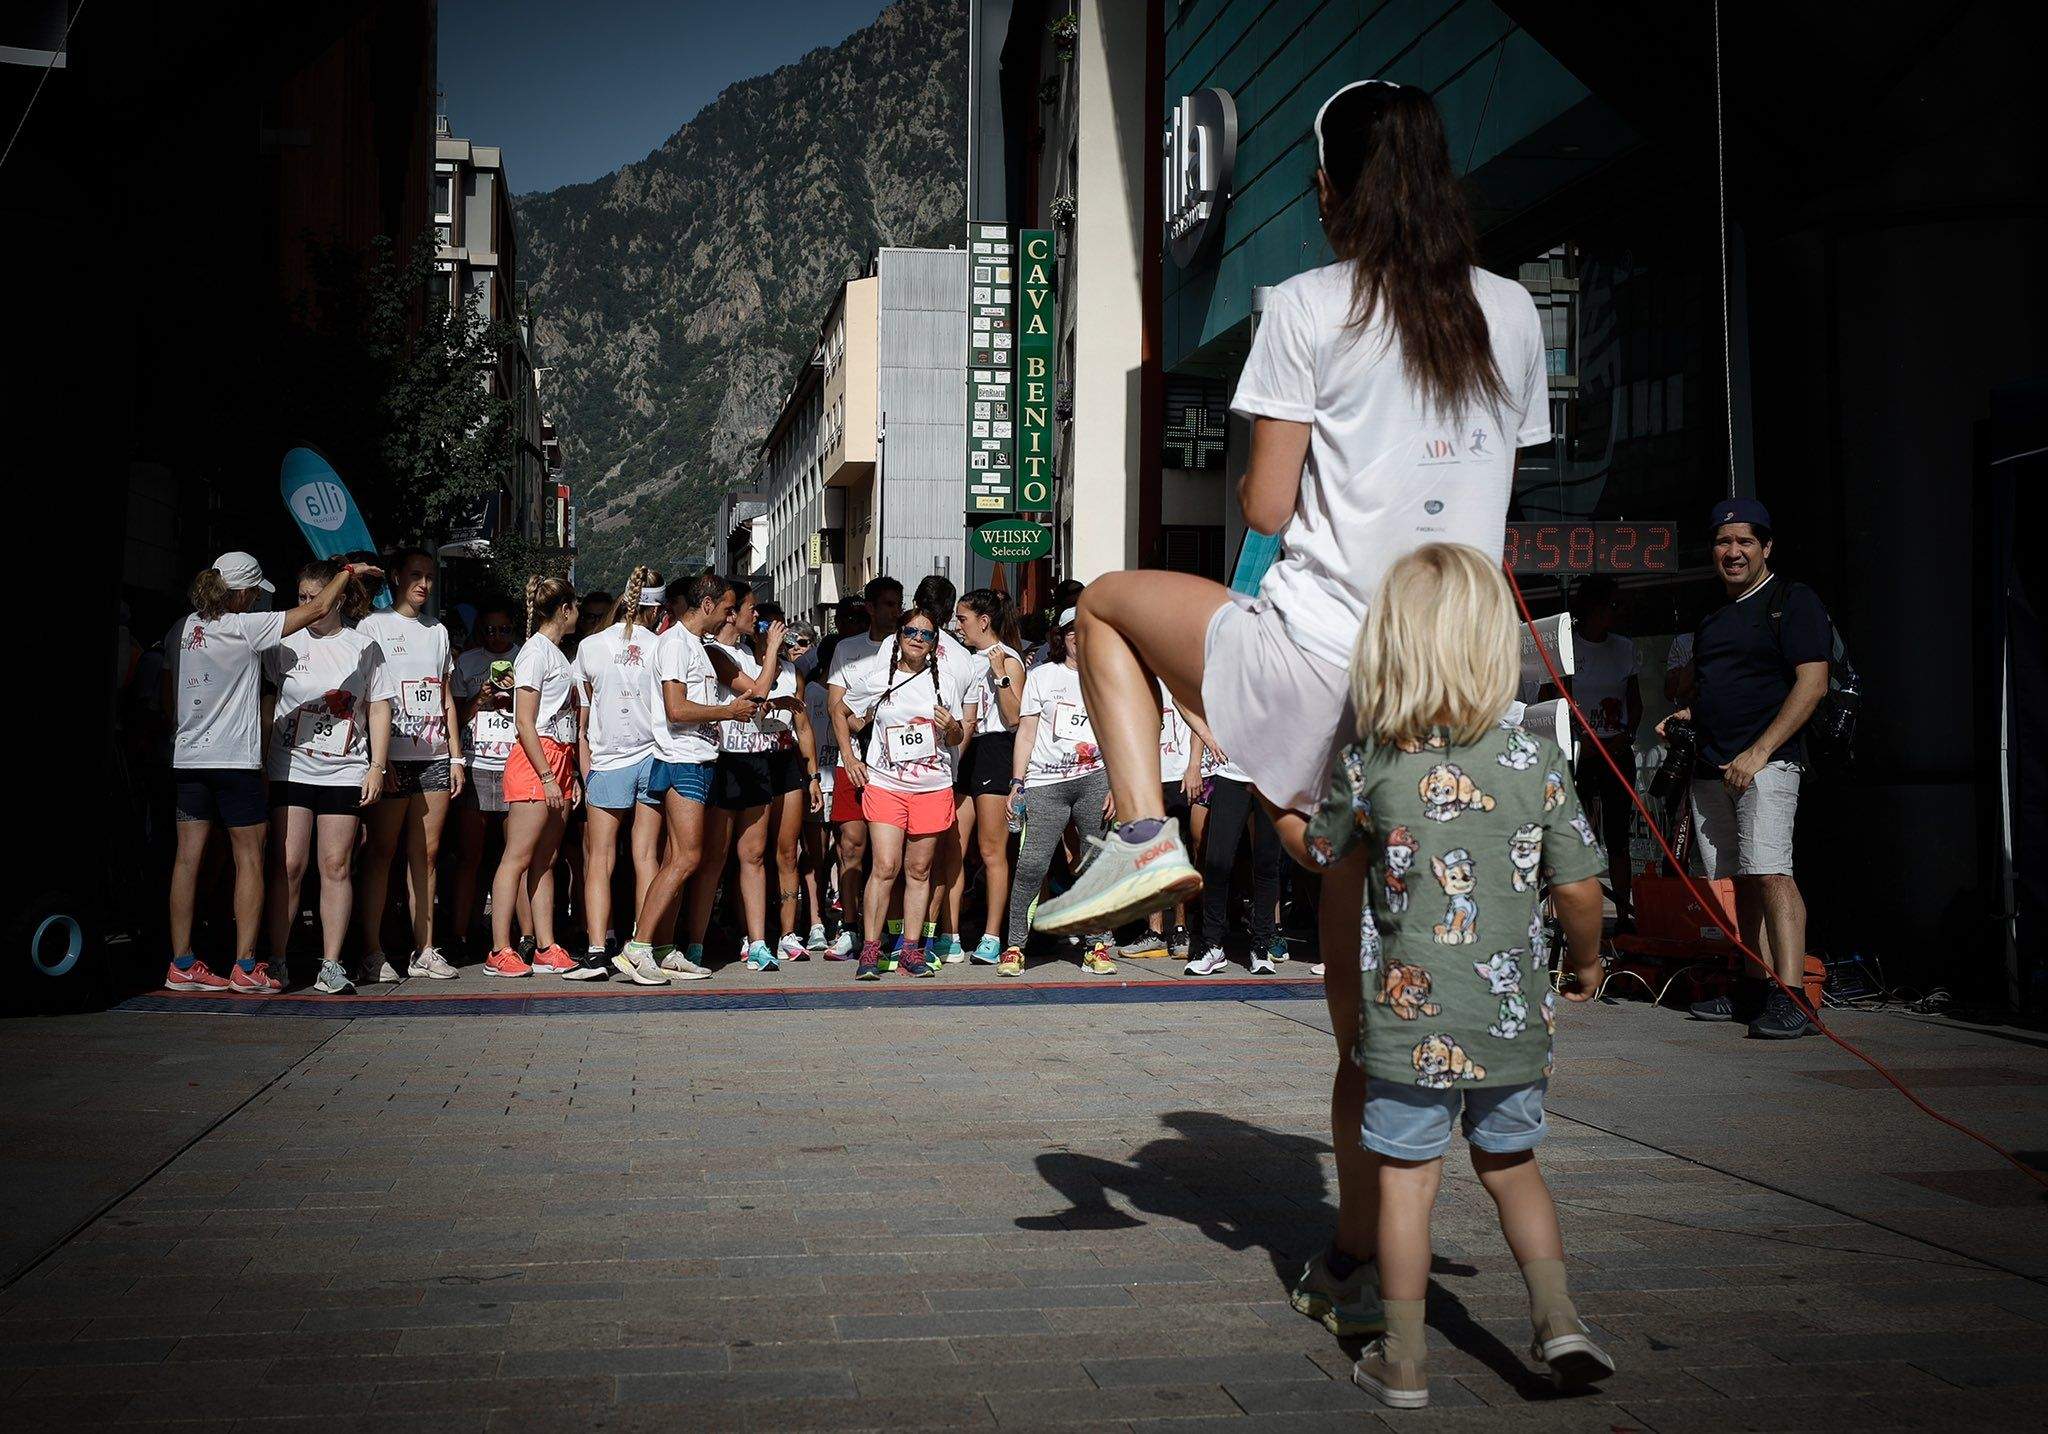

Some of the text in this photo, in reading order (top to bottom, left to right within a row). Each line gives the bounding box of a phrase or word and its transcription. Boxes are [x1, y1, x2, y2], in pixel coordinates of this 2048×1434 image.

[1023, 239, 1049, 503] CAVA BENITO
[980, 530, 1042, 543] WHISKY
[992, 546, 1031, 556] Selecció
[414, 690, 433, 702] 187
[487, 718, 509, 729] 146
[1070, 714, 1089, 727] 57
[313, 722, 333, 737] 33
[899, 732, 923, 746] 168
[1132, 839, 1176, 869] HOKA
